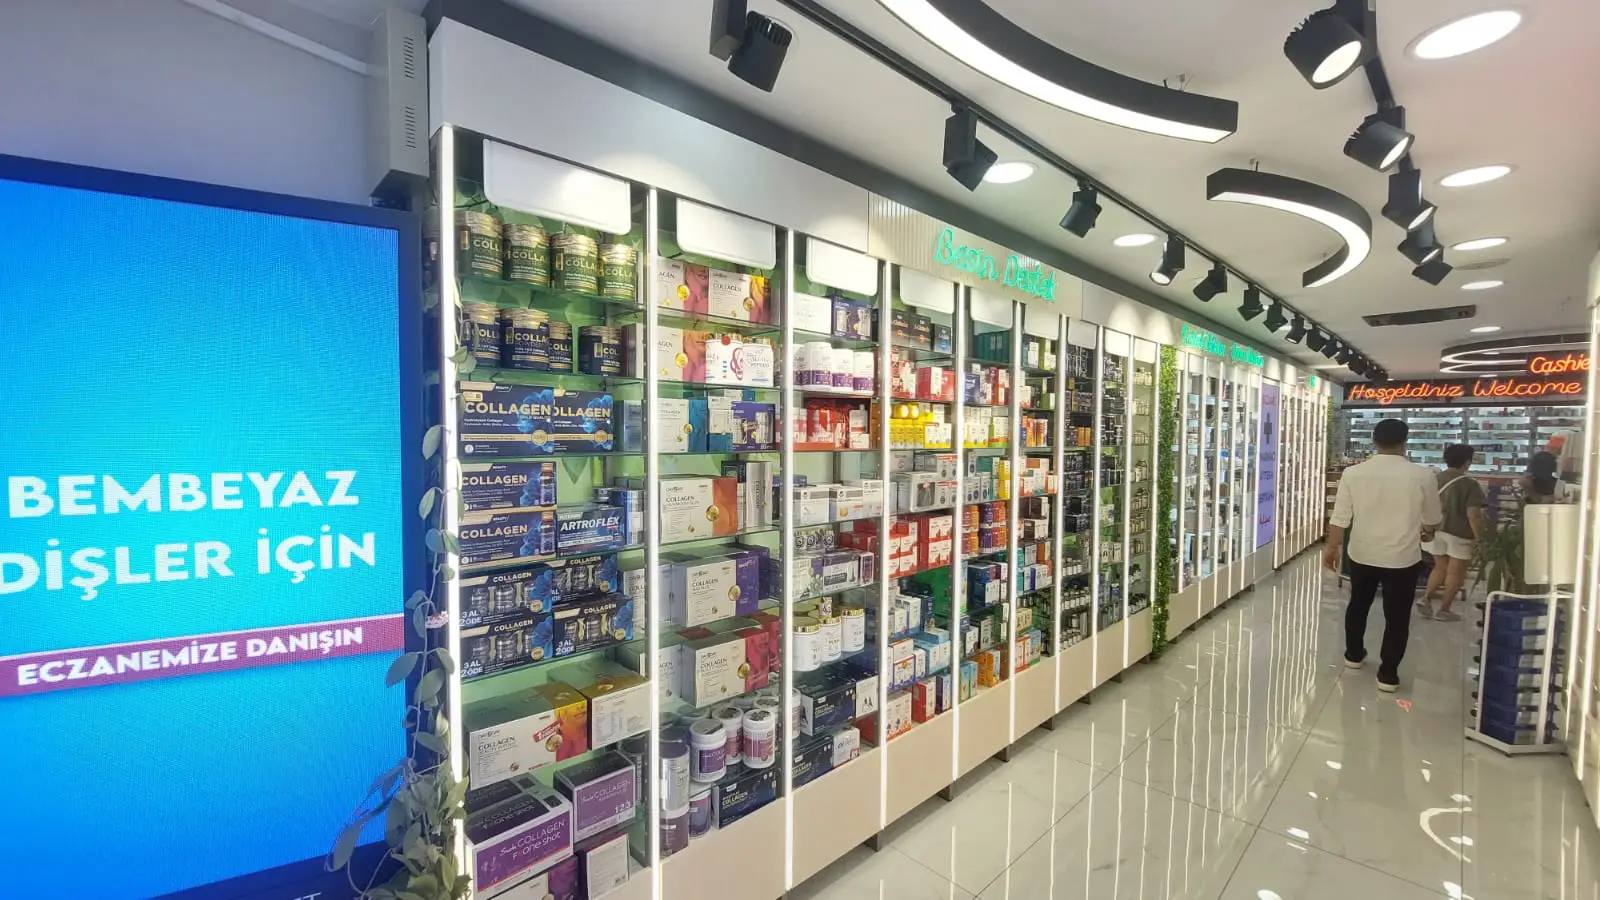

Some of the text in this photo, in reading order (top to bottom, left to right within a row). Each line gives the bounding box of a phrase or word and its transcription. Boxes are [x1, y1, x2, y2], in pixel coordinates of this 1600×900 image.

[1473, 379, 1583, 396] Welcome
[464, 401, 552, 416] COLLAGEN
[554, 407, 611, 418] OLLAGEN
[462, 474, 527, 486] COLLAGEN
[8, 470, 360, 519] BEMBEYAZ
[560, 516, 620, 532] ARTROFLEX
[460, 524, 528, 540] COLLAGEN
[0, 524, 376, 601] DİŞLER İÇİN
[569, 556, 601, 565] COLLAGEN
[492, 572, 532, 583] COLLAGEN
[583, 603, 617, 614] COLLAGEN
[494, 619, 533, 632] COLLAGEN
[17, 626, 364, 686] ECZANEMİZE DANIŞIN
[478, 736, 516, 751] COLLAGEN
[516, 820, 565, 847] COLLAGEN
